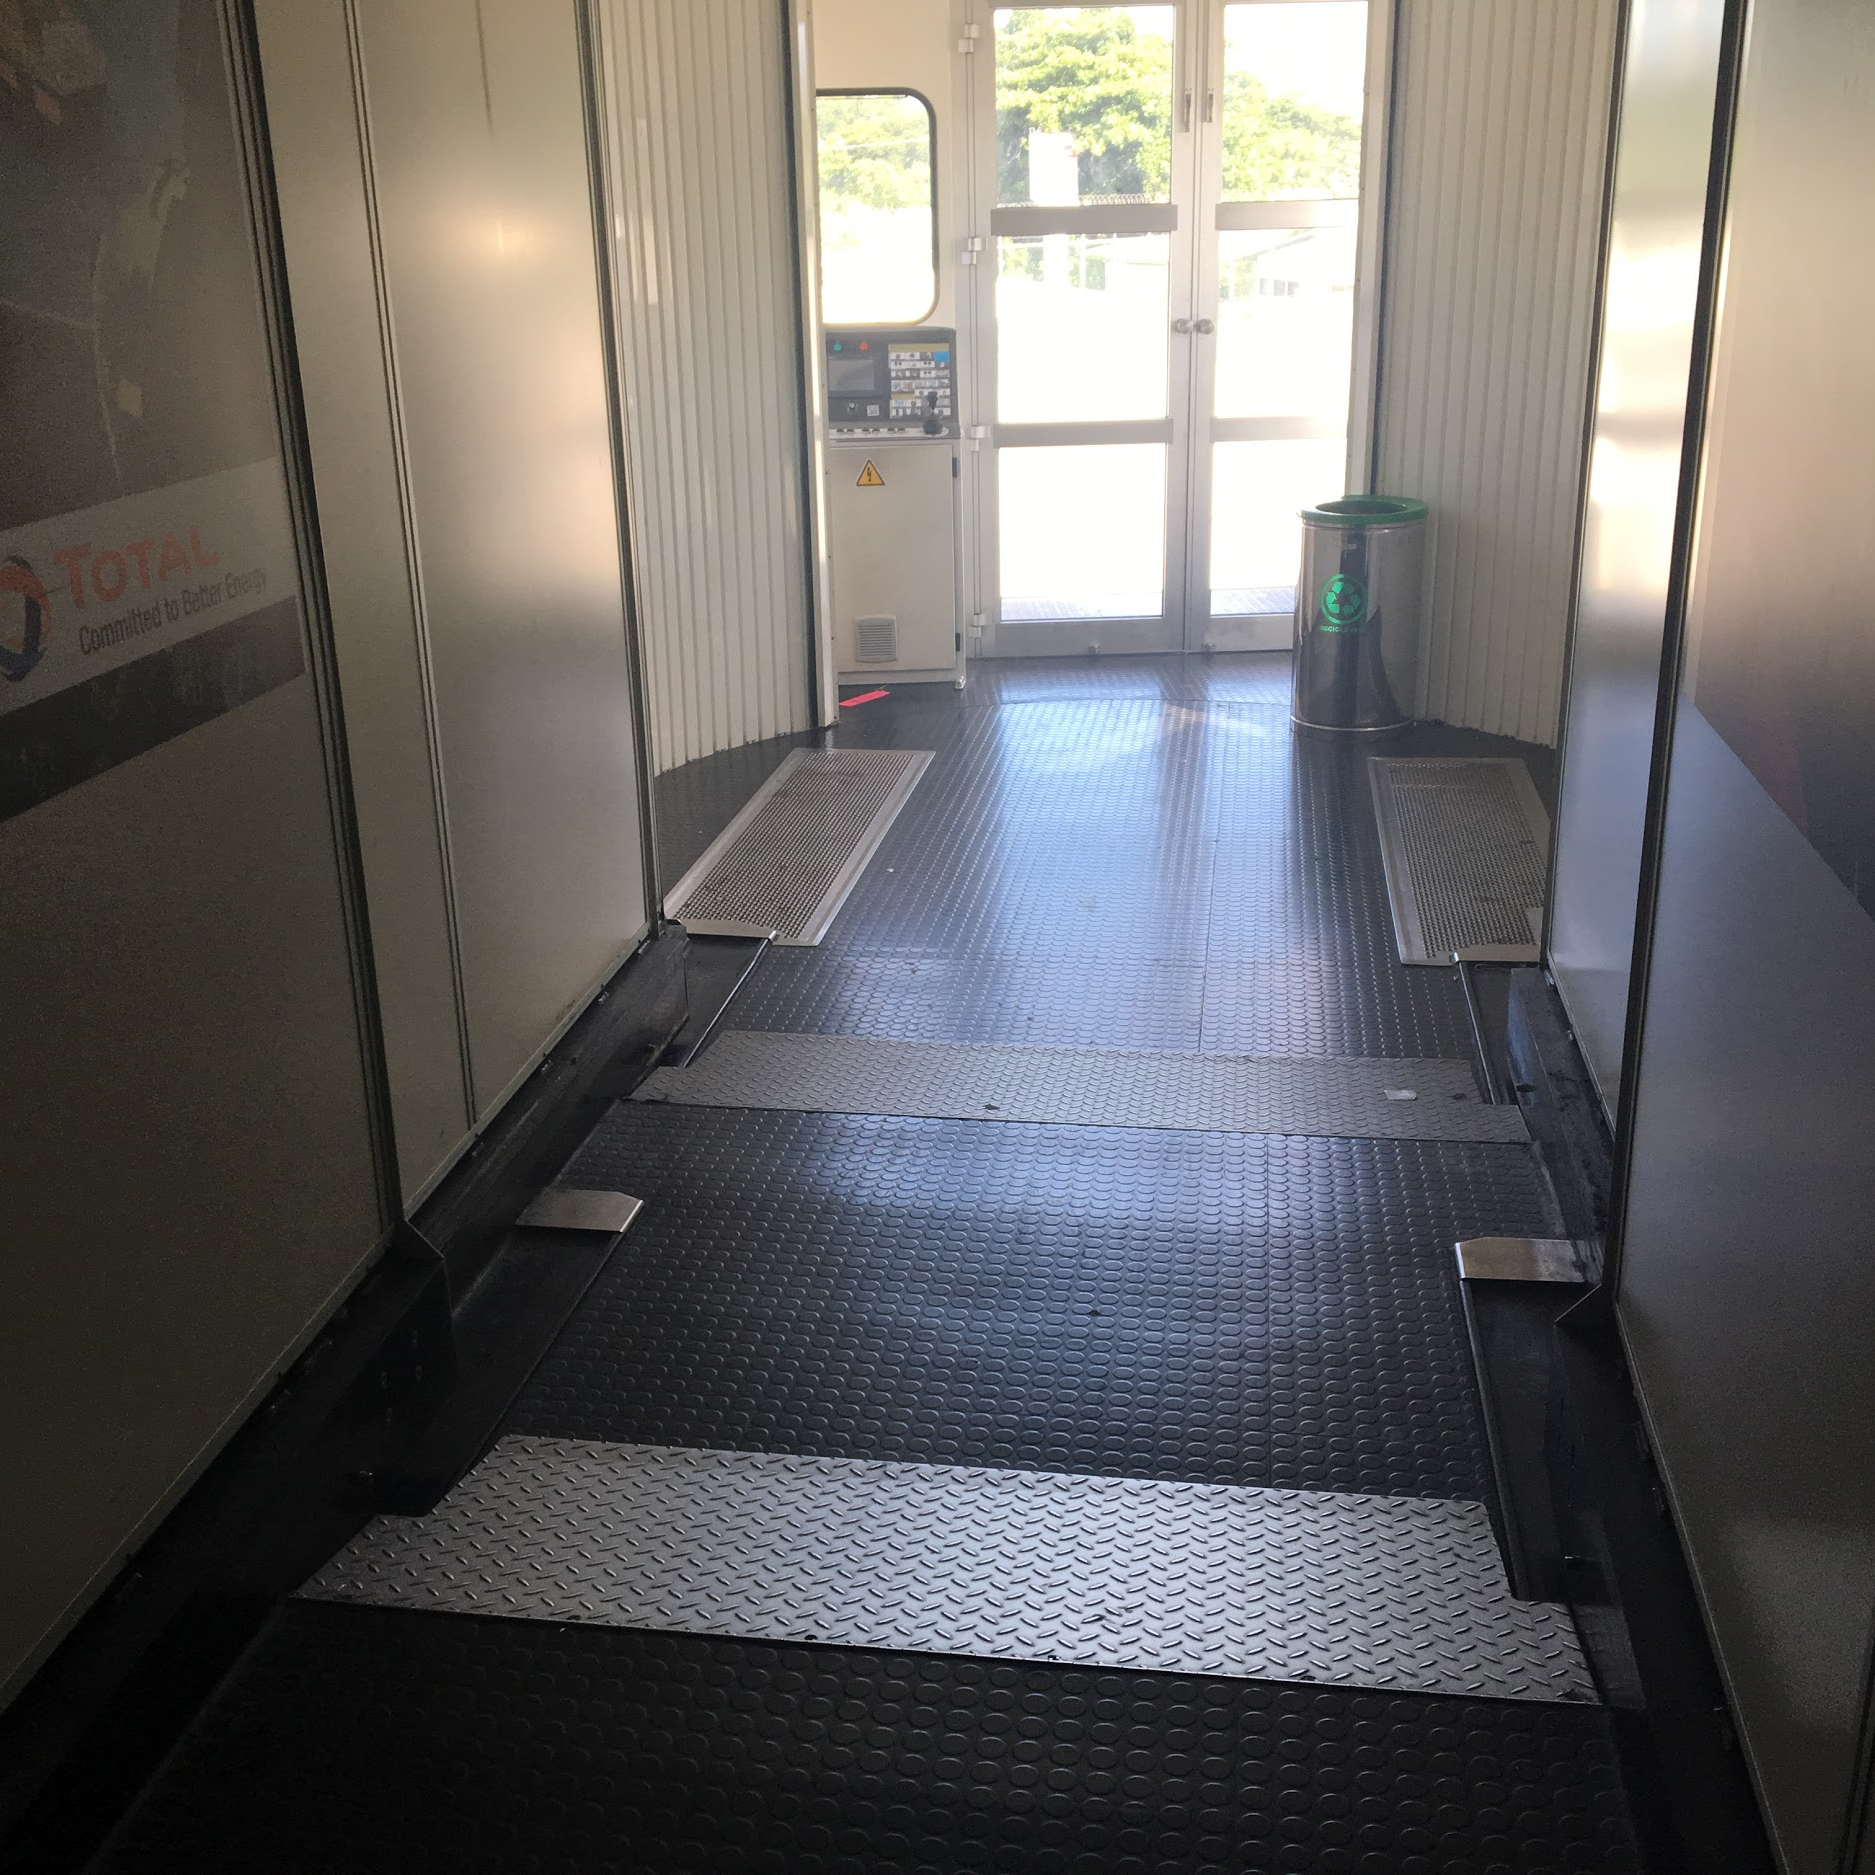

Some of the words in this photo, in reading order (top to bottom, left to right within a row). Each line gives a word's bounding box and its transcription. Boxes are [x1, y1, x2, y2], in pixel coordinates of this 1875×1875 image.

[53, 525, 219, 609] TOTAL
[78, 601, 162, 656] Committed
[164, 596, 181, 624] to
[181, 580, 222, 616] Better
[224, 566, 268, 600] Energy
